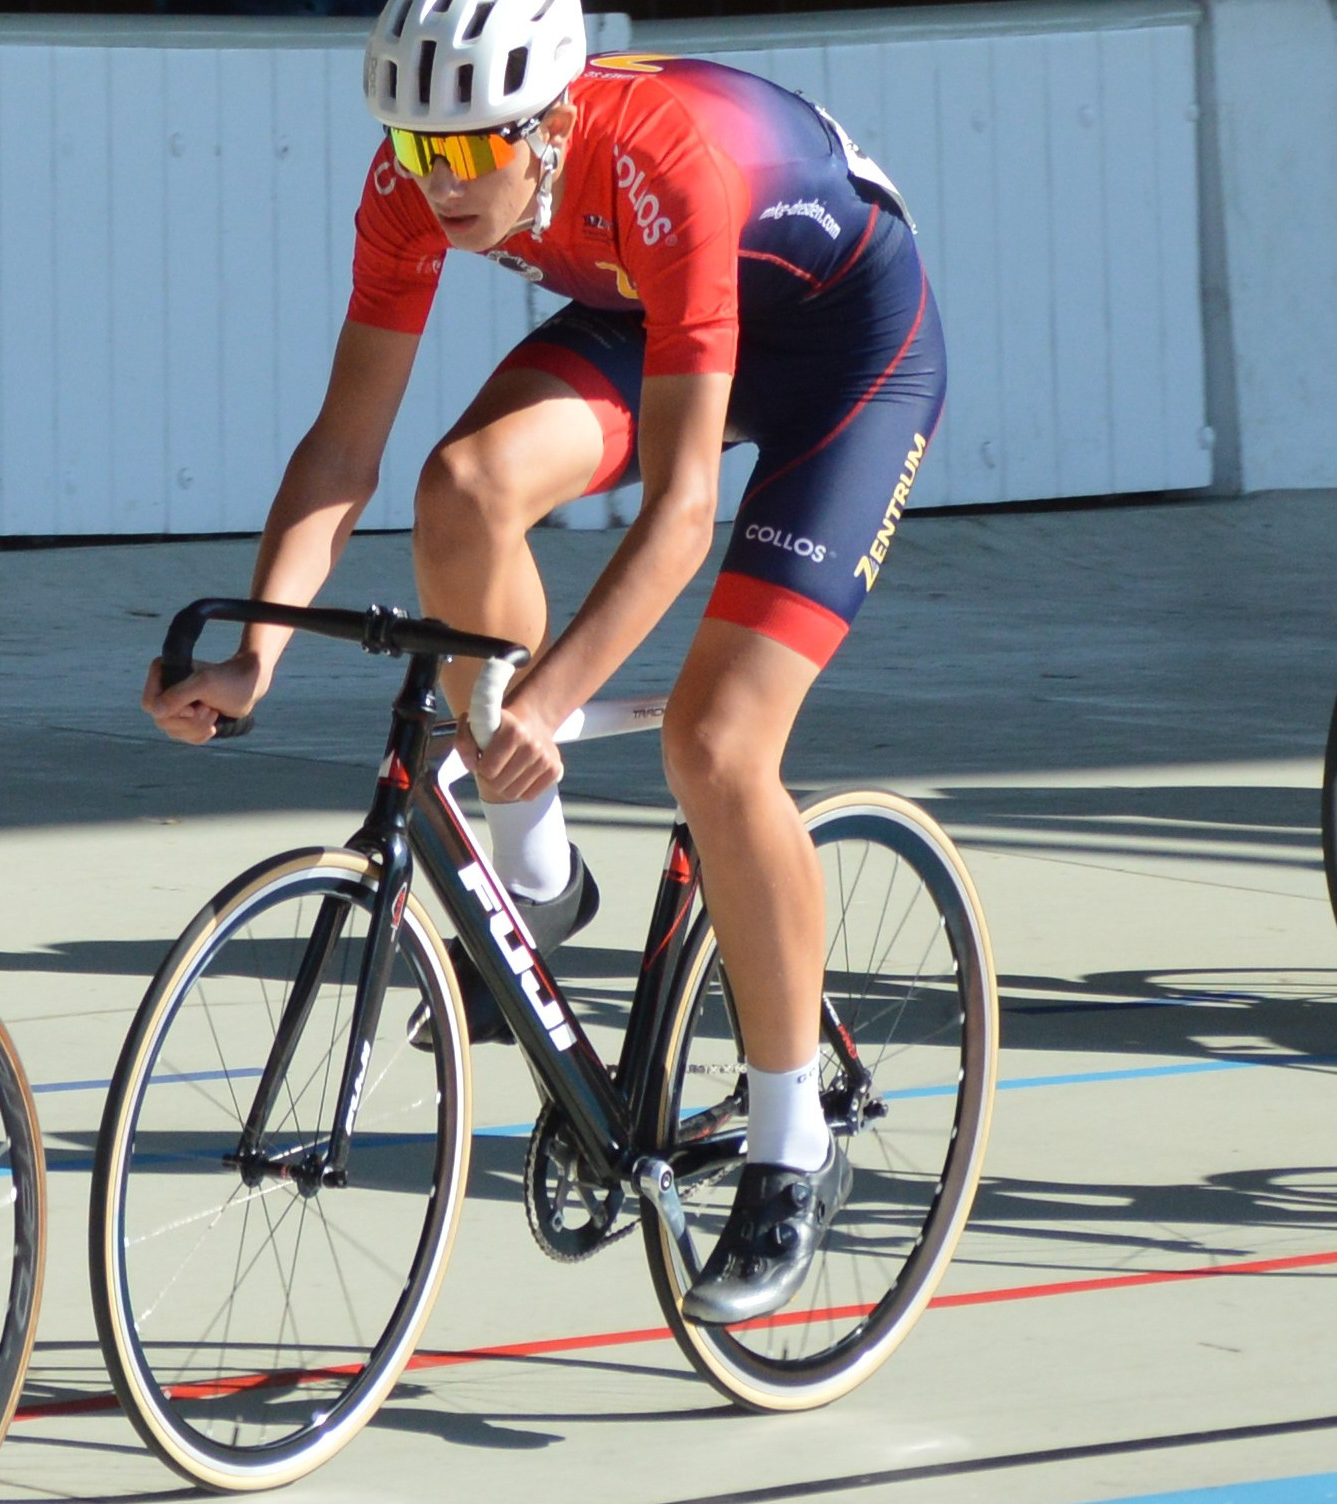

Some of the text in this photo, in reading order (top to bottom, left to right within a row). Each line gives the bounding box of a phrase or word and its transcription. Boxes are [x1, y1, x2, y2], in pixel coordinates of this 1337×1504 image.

[758, 198, 842, 241] mkg-dresden.com
[745, 523, 827, 564] COLLOS
[853, 432, 927, 593] ZENTRUM
[458, 861, 578, 1052] FUJI
